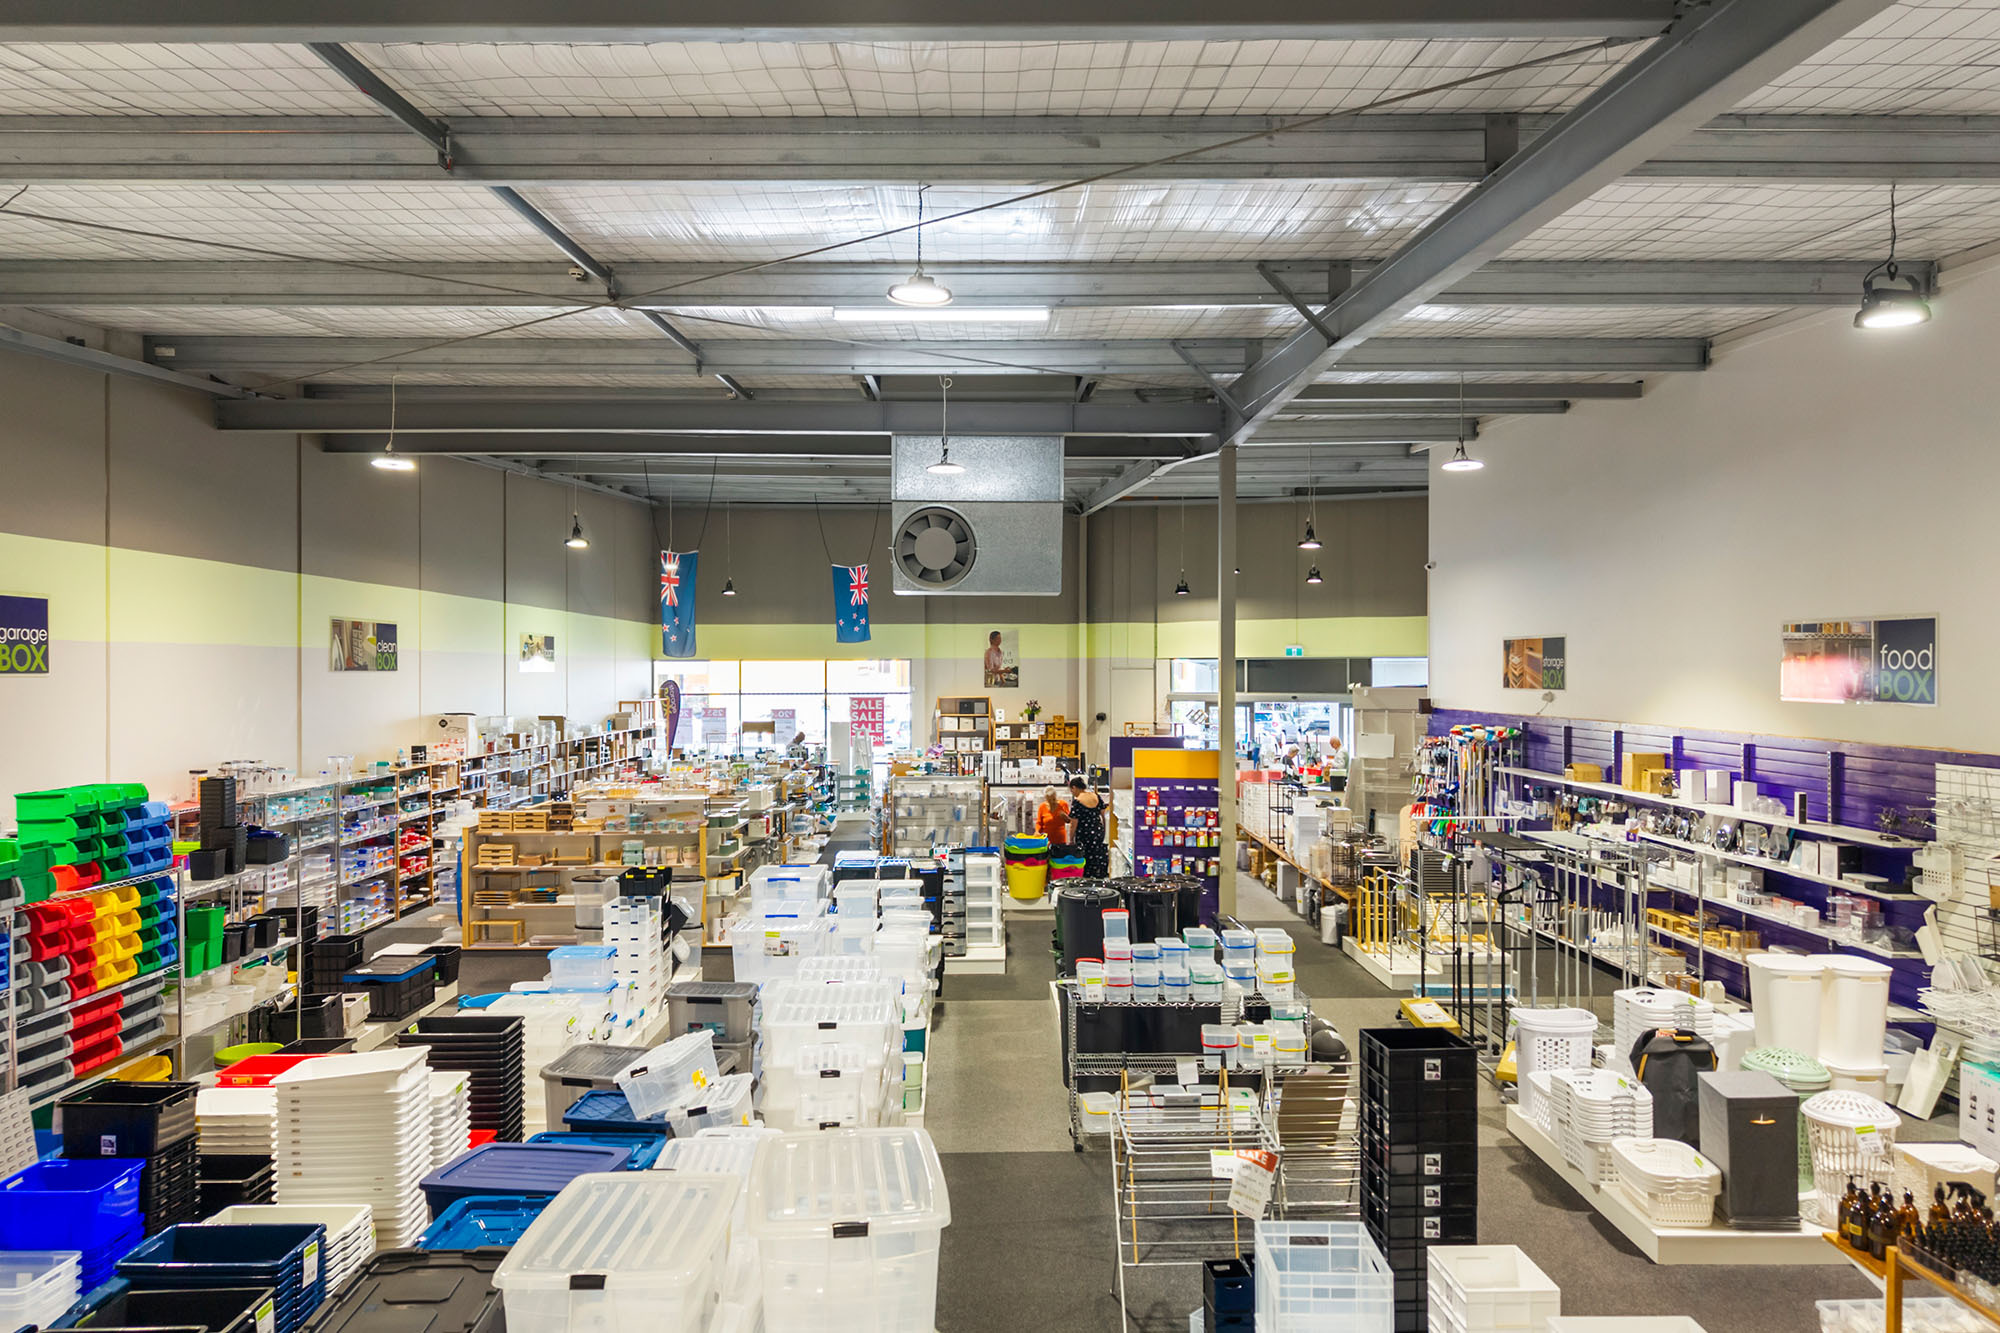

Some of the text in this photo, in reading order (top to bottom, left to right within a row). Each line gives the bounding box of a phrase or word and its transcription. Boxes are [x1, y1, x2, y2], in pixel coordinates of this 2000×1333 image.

[0, 627, 47, 645] garage
[377, 640, 396, 653] clean
[0, 644, 47, 672] BOX
[377, 653, 396, 670] BOX
[1880, 643, 1932, 670] food
[1543, 669, 1564, 688] BOX
[1880, 670, 1932, 701] BOX
[851, 700, 882, 710] SALE
[851, 711, 882, 721] SALE
[851, 722, 882, 733] SALE
